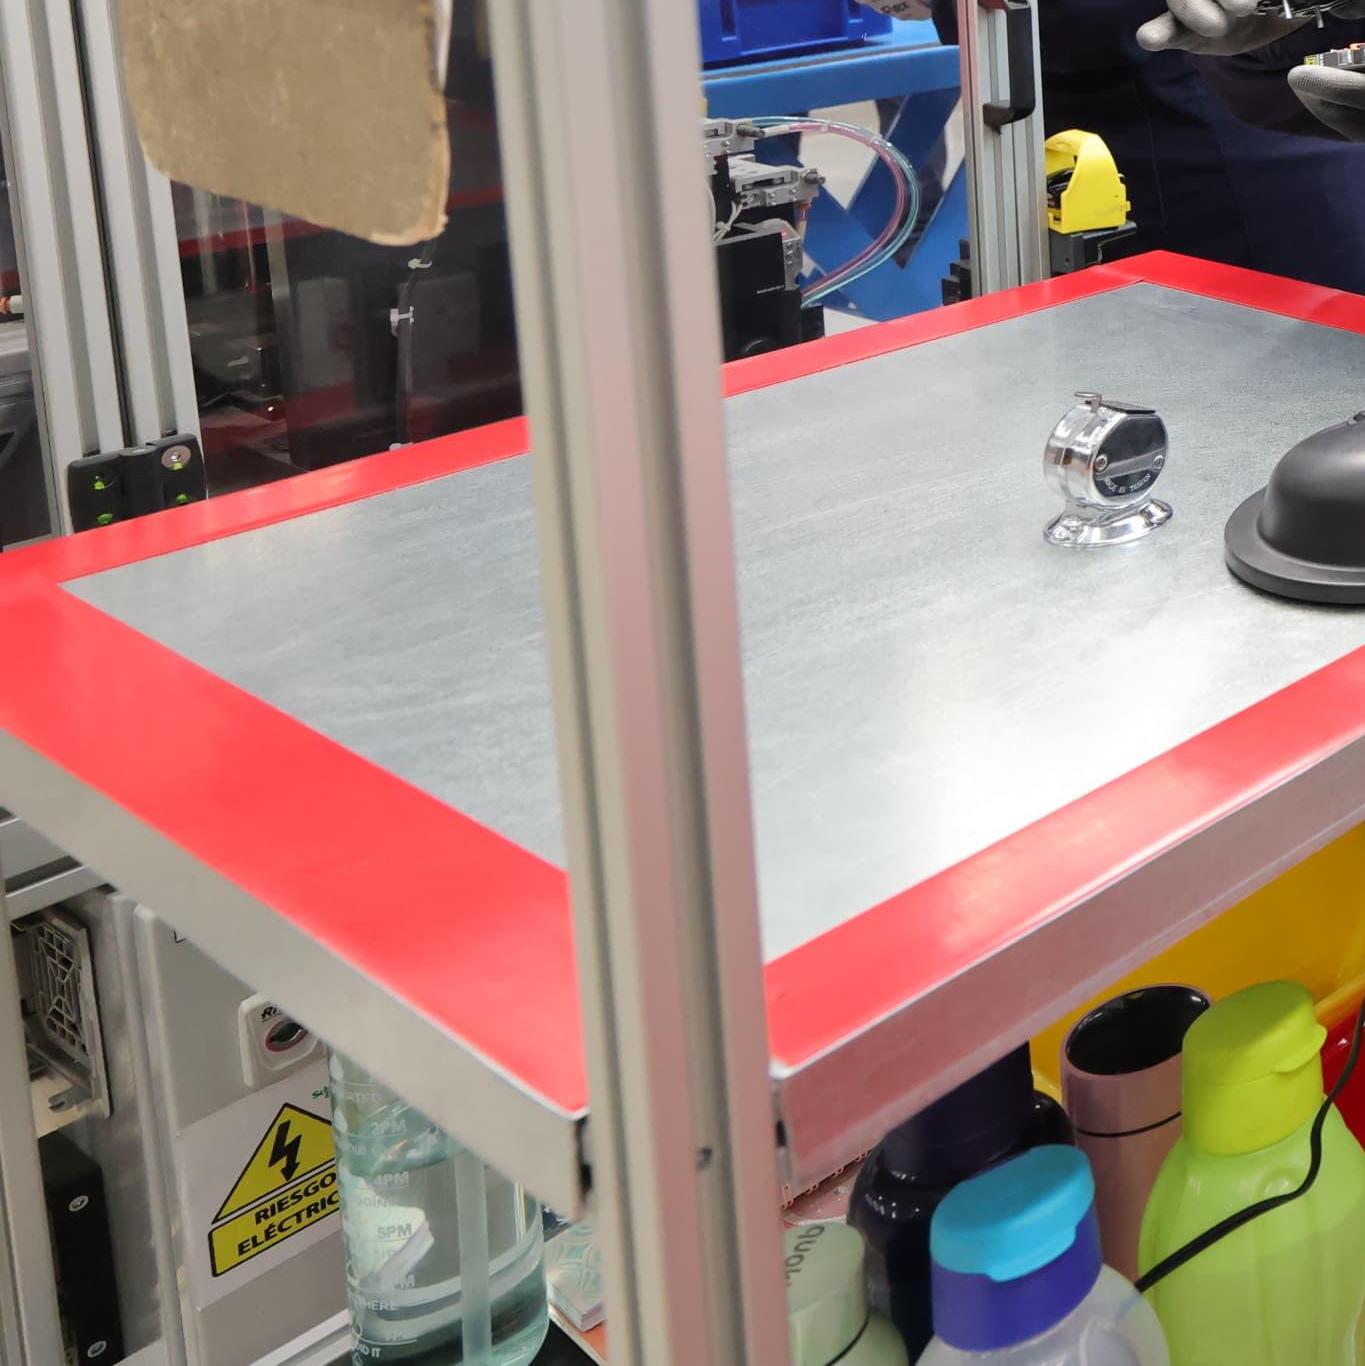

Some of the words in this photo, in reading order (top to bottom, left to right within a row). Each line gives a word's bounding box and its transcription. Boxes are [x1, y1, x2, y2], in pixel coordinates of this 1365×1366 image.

[237, 1190, 340, 1256] ELÉCTRIC
[255, 1172, 336, 1225] RIESGO
[378, 1224, 412, 1239] 5PM
